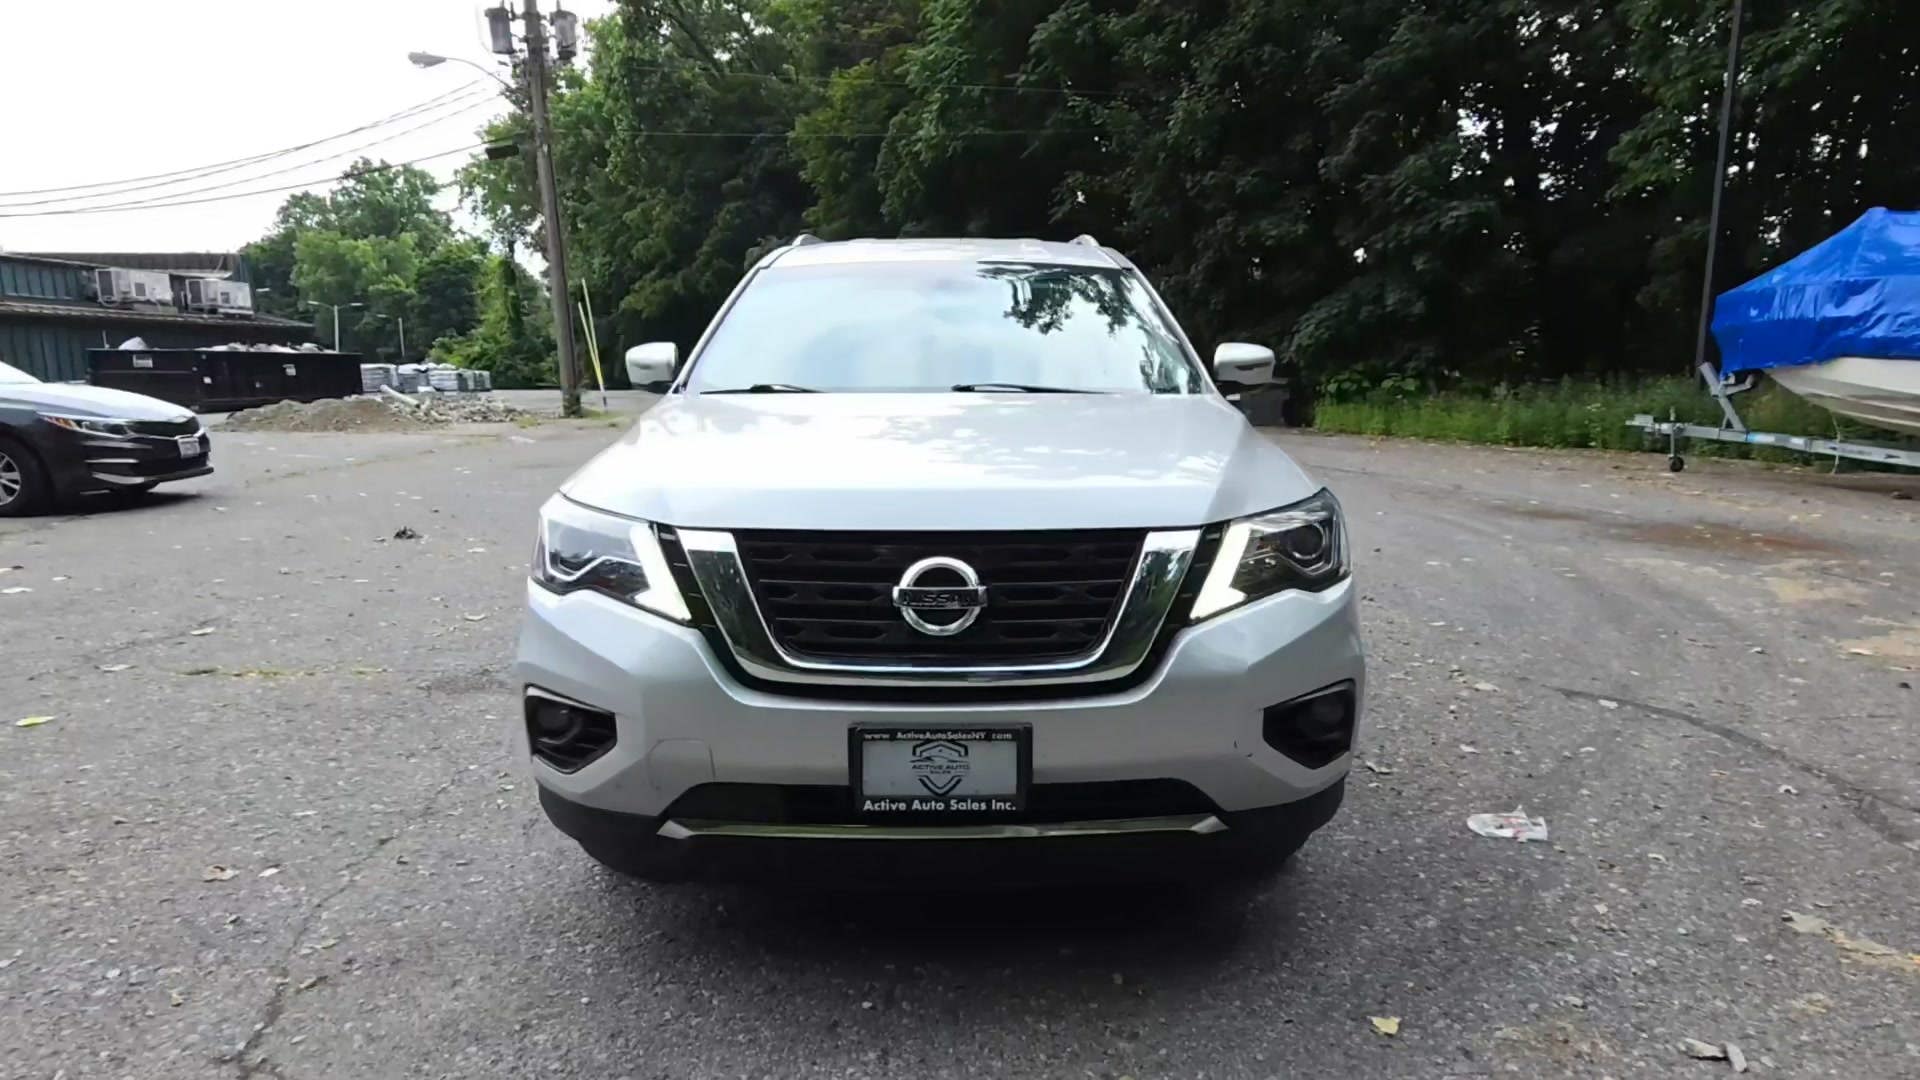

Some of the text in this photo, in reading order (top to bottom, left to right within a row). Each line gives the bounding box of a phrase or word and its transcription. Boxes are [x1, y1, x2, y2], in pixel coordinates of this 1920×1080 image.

[863, 800, 1017, 811] Active Auto Sales Inc.
